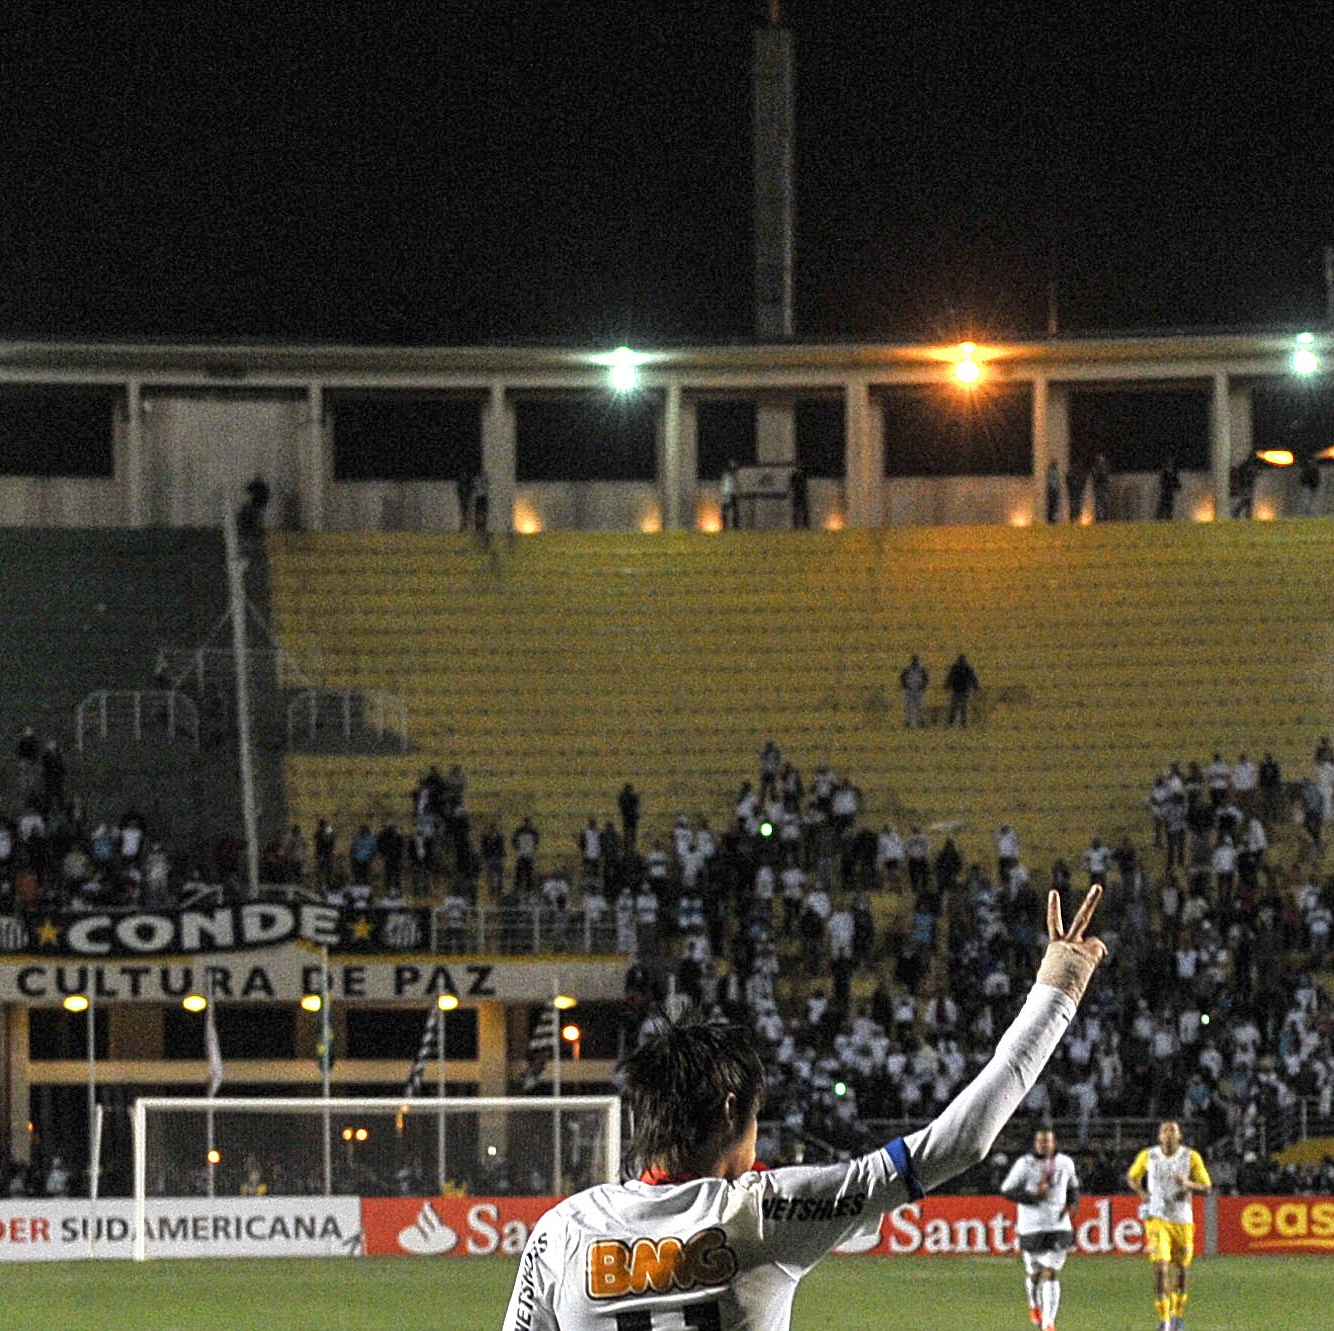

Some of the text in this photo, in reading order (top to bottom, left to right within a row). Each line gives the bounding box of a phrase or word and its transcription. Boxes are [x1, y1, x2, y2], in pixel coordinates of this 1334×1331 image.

[68, 903, 340, 955] CONDE
[17, 965, 496, 997] CULTURA DE PAZ
[586, 1227, 738, 1300] BMG
